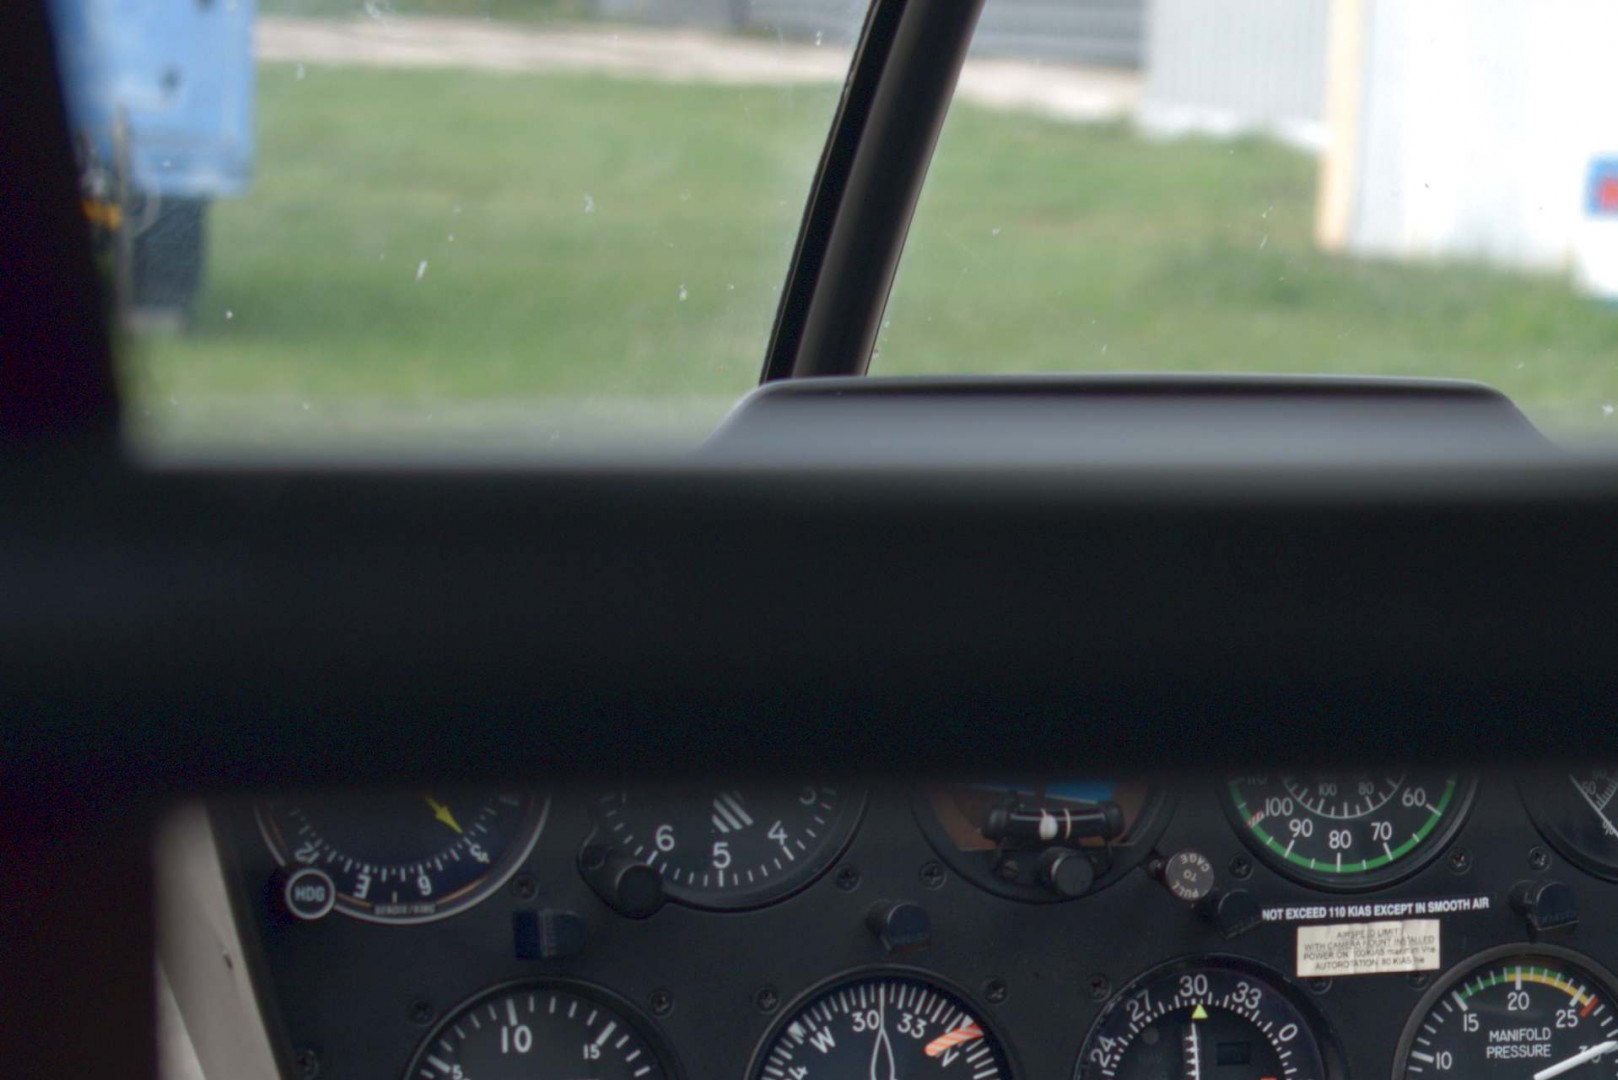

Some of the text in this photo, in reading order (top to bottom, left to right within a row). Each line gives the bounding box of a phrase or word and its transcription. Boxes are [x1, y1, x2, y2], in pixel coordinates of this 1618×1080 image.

[1265, 796, 1294, 817] 100
[1401, 787, 1427, 808] 60
[655, 823, 676, 852] 6
[767, 819, 788, 845] 4
[1289, 818, 1314, 838] 90
[1370, 820, 1393, 842] 70
[1328, 830, 1352, 849] 80
[712, 841, 732, 869] 5
[1262, 897, 1490, 920] NOT EXCEED 110 KIAS EXCEPT IN SMOOTH AIR
[1179, 973, 1209, 997] 30
[1232, 981, 1263, 1010] 33
[1125, 988, 1151, 1022] 27
[1507, 991, 1531, 1012] 20
[850, 1009, 881, 1033] 30
[896, 1012, 928, 1040] 33
[1462, 1012, 1480, 1033] 15
[1555, 1009, 1580, 1029] 25
[501, 1023, 533, 1054] 10
[808, 1025, 838, 1055] W
[1488, 1026, 1552, 1042] MANIFOLD
[582, 1043, 602, 1061] 15
[1089, 1034, 1118, 1068] 24
[1435, 1051, 1453, 1071] 10
[1486, 1044, 1552, 1060] PRESSURE
[452, 1064, 464, 1079] 5
